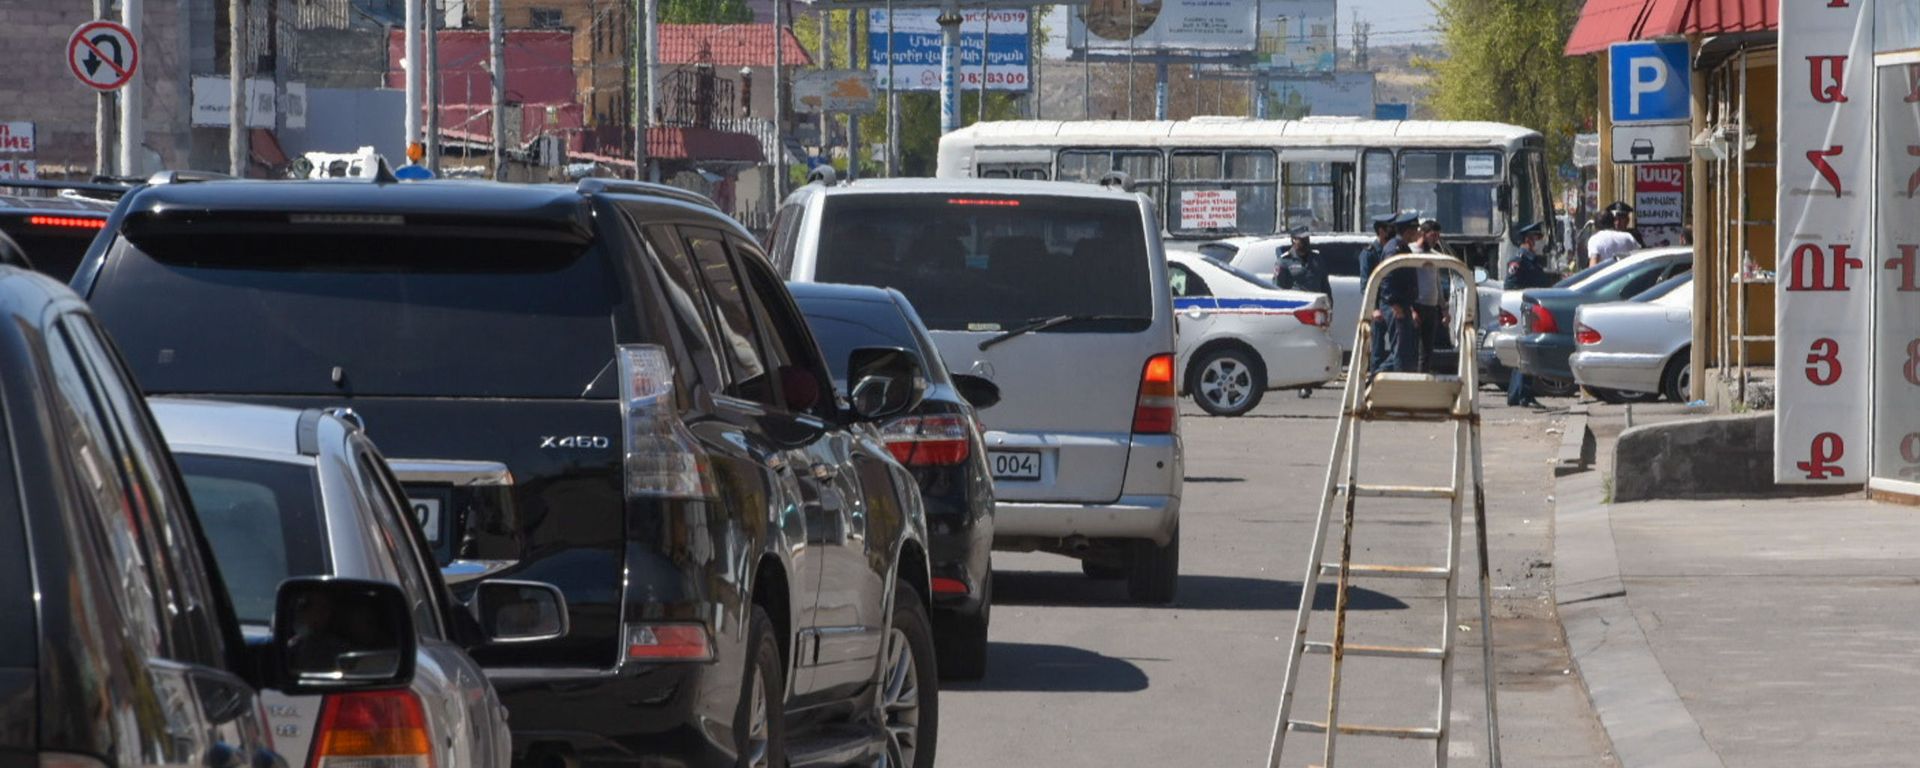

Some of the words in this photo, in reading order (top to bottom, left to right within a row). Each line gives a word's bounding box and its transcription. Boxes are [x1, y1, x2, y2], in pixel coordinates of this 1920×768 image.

[1629, 56, 1668, 115] P
[1786, 0, 1863, 479] ԱՀՈՒՅՔ
[996, 455, 1032, 474] 004
